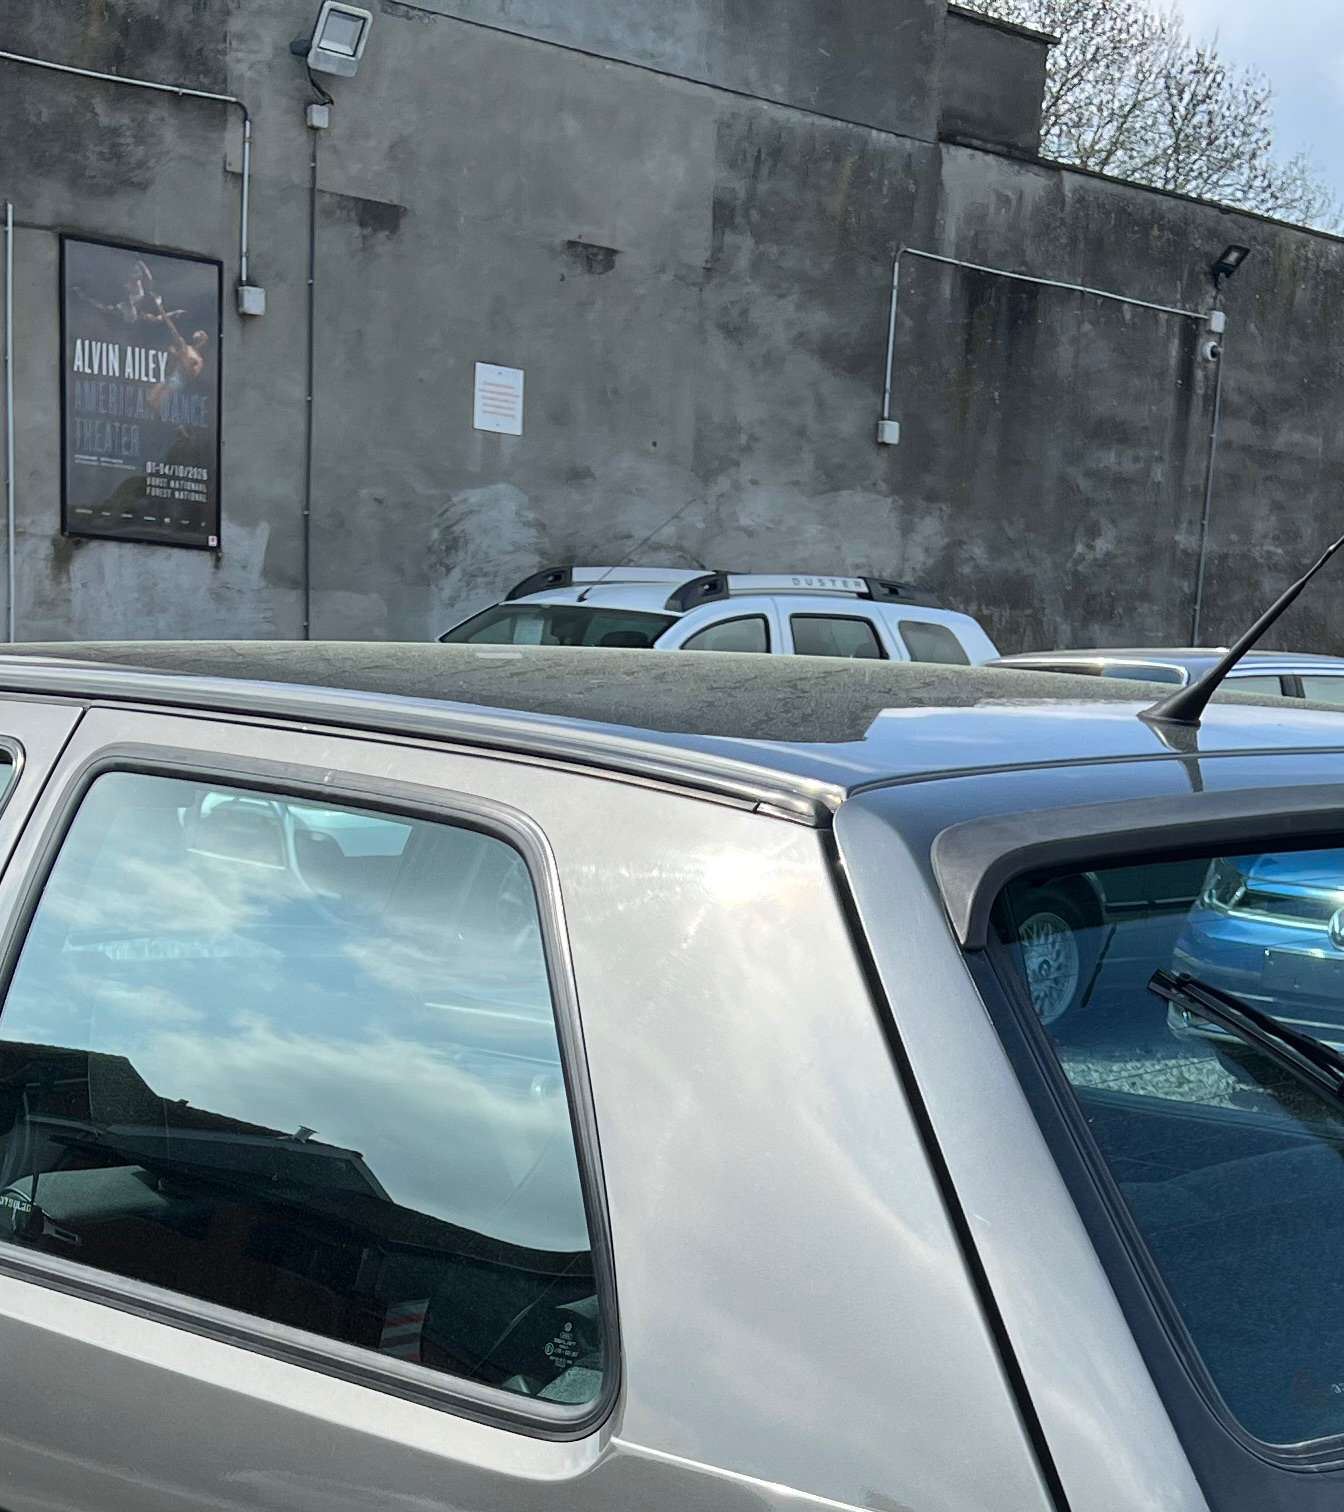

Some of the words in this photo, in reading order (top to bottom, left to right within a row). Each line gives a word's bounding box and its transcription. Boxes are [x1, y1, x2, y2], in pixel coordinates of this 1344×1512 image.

[73, 338, 120, 377] ALVIN
[124, 345, 168, 384] AILEY
[792, 577, 862, 588] DUSTER
